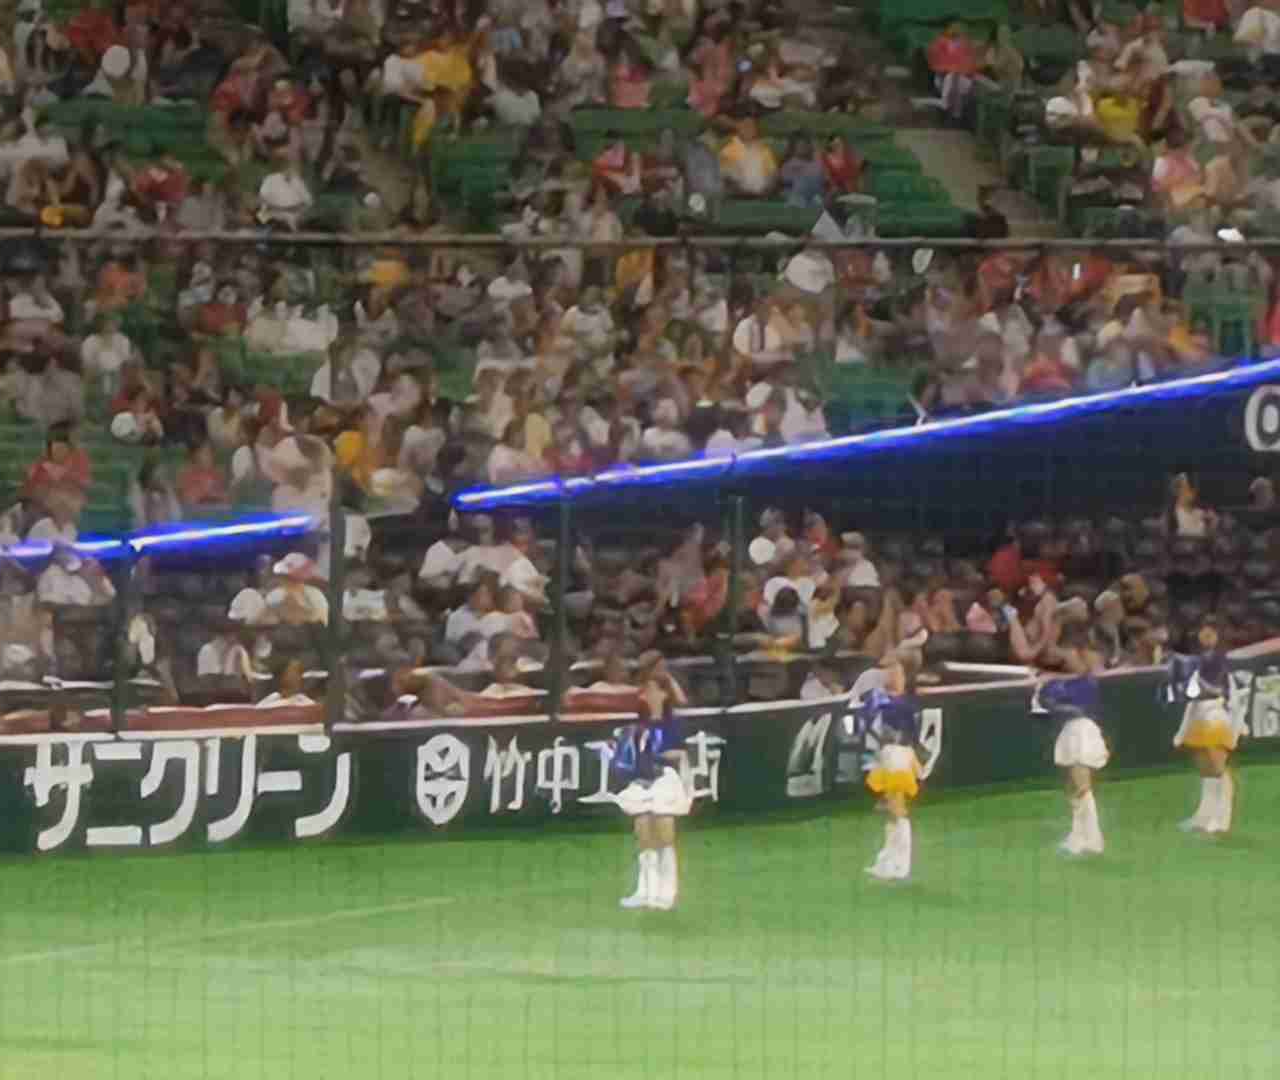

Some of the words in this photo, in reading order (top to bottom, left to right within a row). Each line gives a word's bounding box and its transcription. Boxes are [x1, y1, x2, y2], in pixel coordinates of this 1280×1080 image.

[24, 733, 351, 851] サニクリーン
[484, 730, 727, 814] 竹中工店
